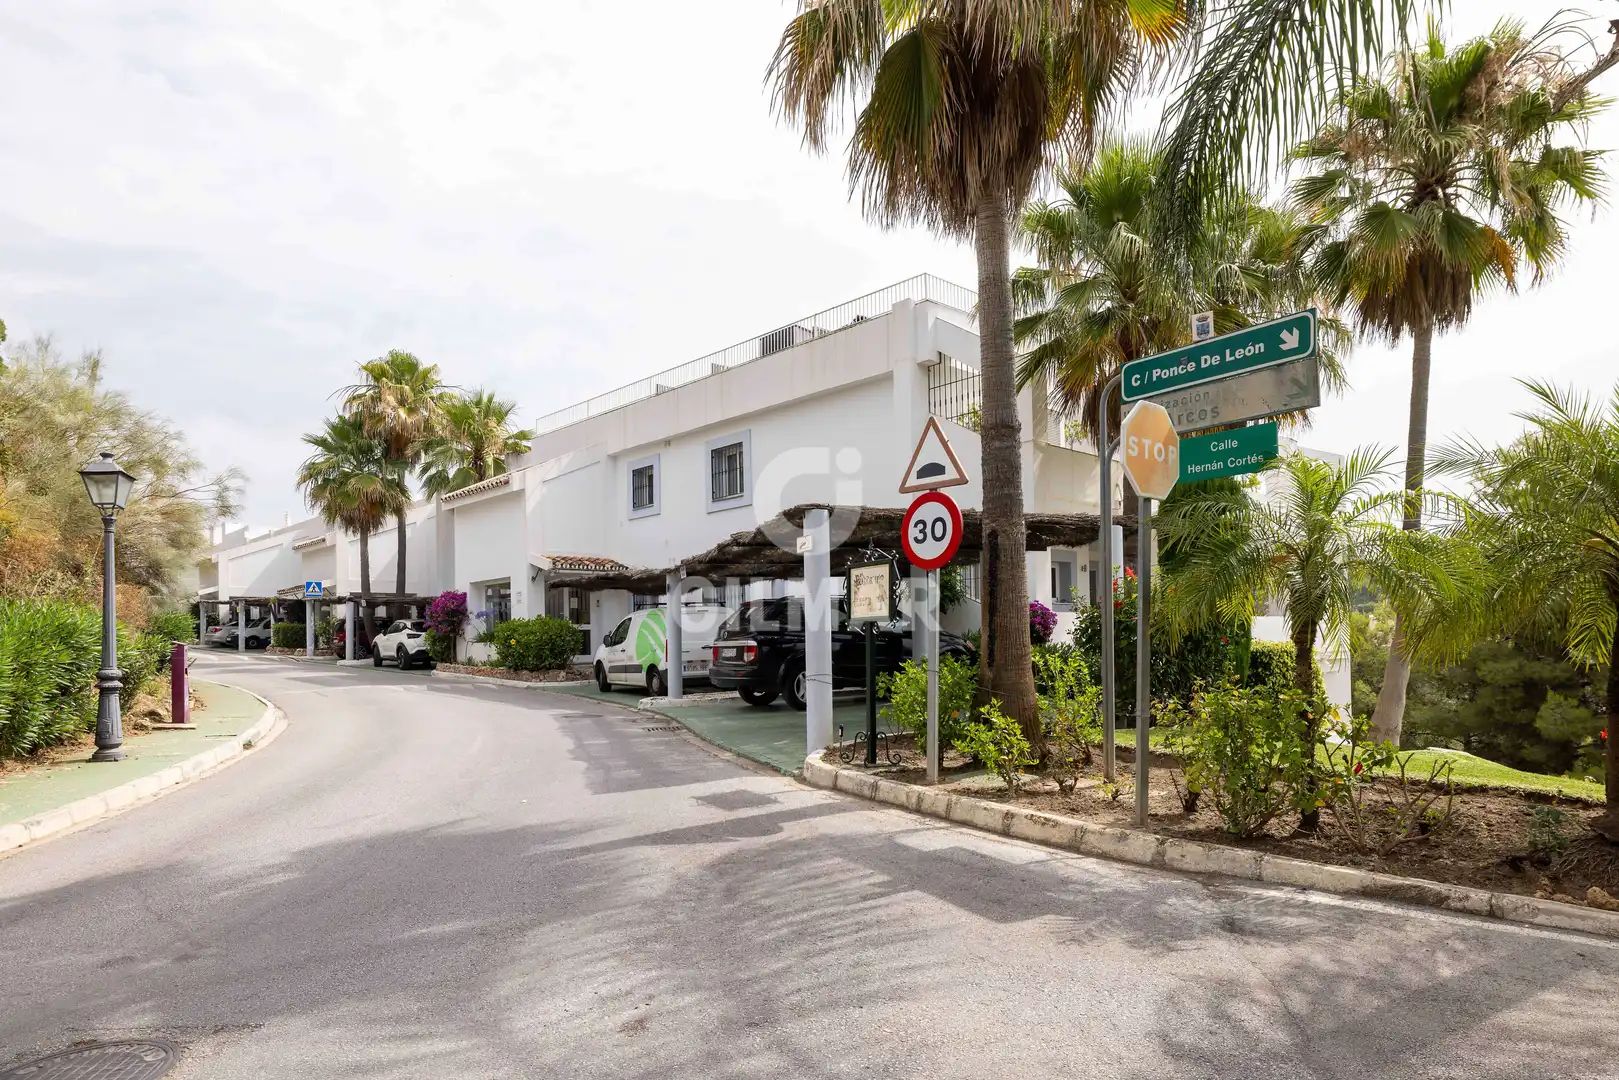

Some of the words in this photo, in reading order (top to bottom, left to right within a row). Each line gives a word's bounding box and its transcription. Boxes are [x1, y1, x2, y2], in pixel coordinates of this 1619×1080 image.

[1152, 362, 1196, 382] Ponce
[1201, 354, 1221, 369] De
[1225, 342, 1265, 362] León
[1168, 405, 1220, 427] rcos
[1127, 435, 1177, 465] STOP
[1210, 439, 1238, 452] Calle
[1187, 460, 1224, 474] Hernán
[1227, 453, 1264, 468] Cortés
[913, 516, 947, 545] 30
